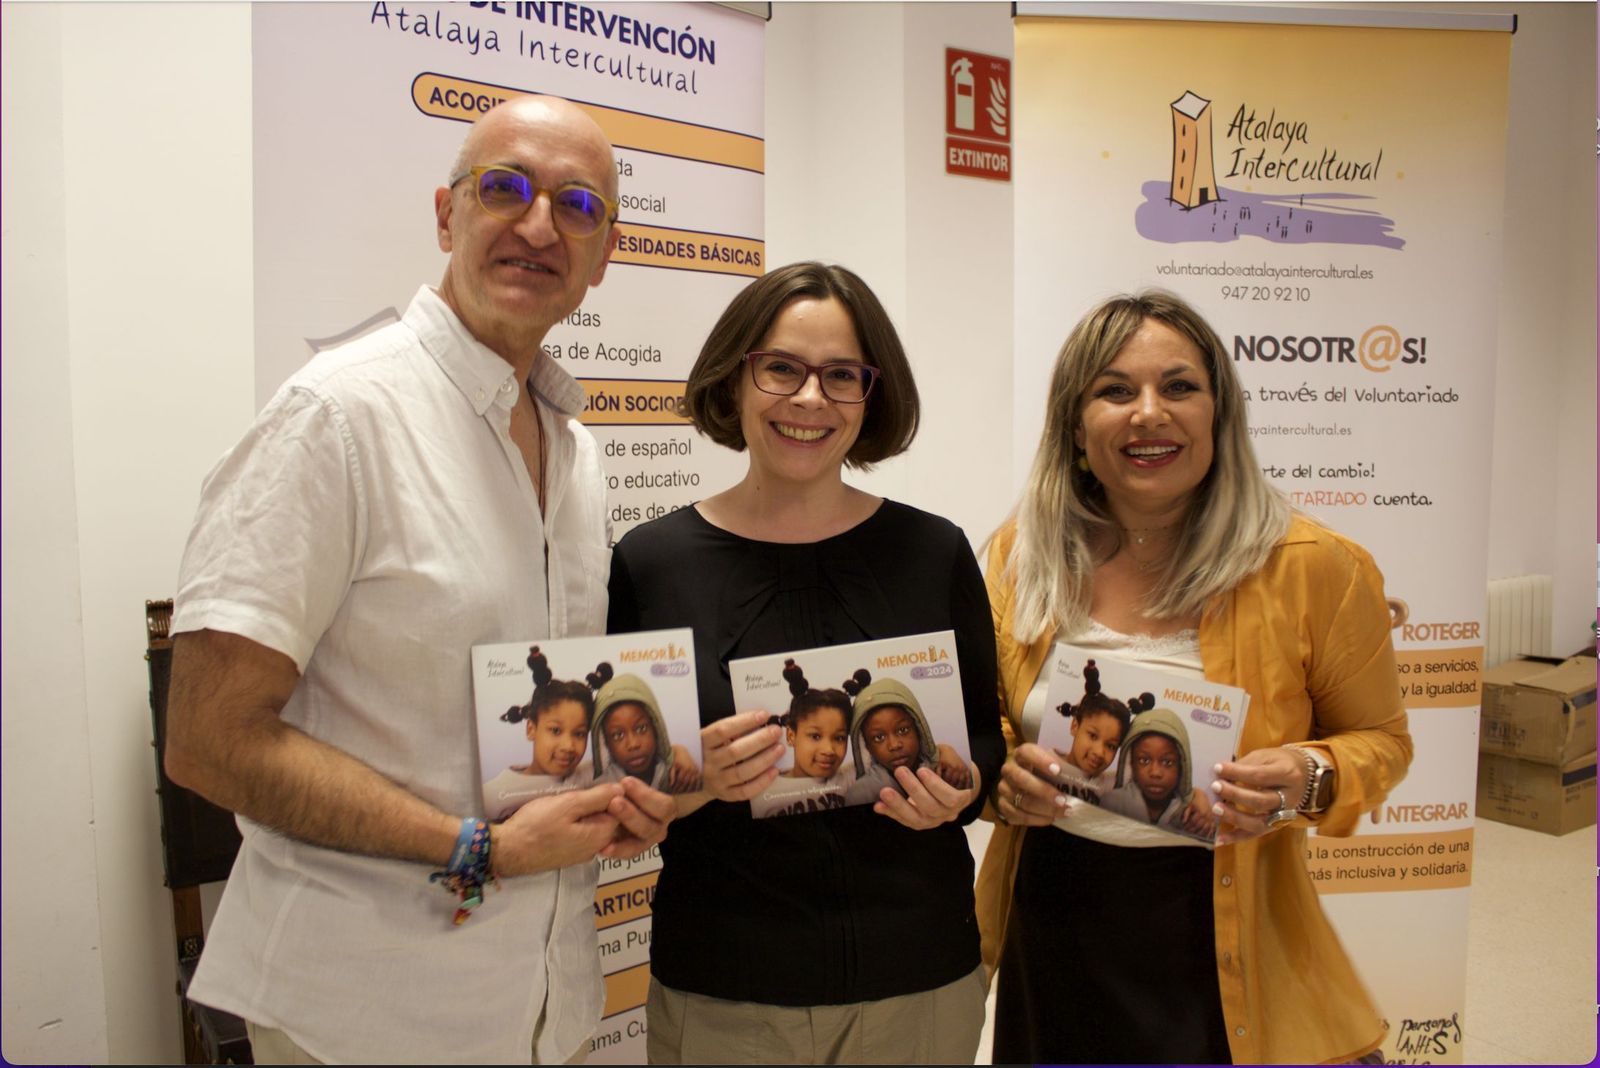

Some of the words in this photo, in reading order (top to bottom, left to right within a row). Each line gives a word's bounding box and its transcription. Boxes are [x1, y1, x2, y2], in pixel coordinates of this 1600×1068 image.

[516, 2, 716, 65] INTERVENCIÓN
[371, 2, 500, 55] Atalaya
[520, 29, 698, 94] Intercultural
[429, 86, 507, 113] ACOGI
[1227, 103, 1309, 154] Atalaya
[949, 147, 1009, 172] EXTINTOR
[1224, 148, 1384, 183] Intercultural
[615, 235, 696, 259] ESIDADES
[700, 242, 761, 267] BÁSICAS
[1156, 261, 1374, 281] voluntariado@atalayaintercultural.es
[1221, 286, 1248, 300] 947
[1251, 286, 1270, 301] 20
[568, 341, 589, 360] de
[595, 342, 662, 366] Acogida
[1234, 325, 1427, 373] NOSOTR@S!
[583, 391, 620, 412] IÓN
[625, 395, 684, 412] SOCIO
[1241, 390, 1252, 401] a
[1259, 381, 1318, 402] través
[1325, 386, 1347, 403] del
[1355, 385, 1460, 403] Voluntariado
[605, 439, 626, 457] de
[631, 438, 692, 460] español
[605, 475, 619, 490] o
[624, 470, 700, 489] educativo
[1292, 464, 1312, 478] del
[1318, 462, 1375, 479] cambio!
[1290, 490, 1367, 507] TARIADO
[1373, 492, 1433, 506] cuenta.
[611, 504, 641, 522] des
[646, 502, 666, 520] de
[926, 664, 952, 677] 2024
[1413, 663, 1422, 674] a
[1424, 659, 1479, 674] servicios,
[1400, 686, 1409, 699] y
[1411, 682, 1423, 696] la
[1425, 681, 1477, 698] igualdad.
[1205, 713, 1231, 728] 2024
[1316, 846, 1329, 859] la
[1332, 843, 1424, 858] construcción
[1427, 842, 1445, 855] de
[1448, 841, 1470, 854] una
[1336, 865, 1395, 879] inclusiva
[1400, 867, 1408, 880] y
[1411, 861, 1468, 877] solidaria.
[627, 930, 652, 949] Pu
